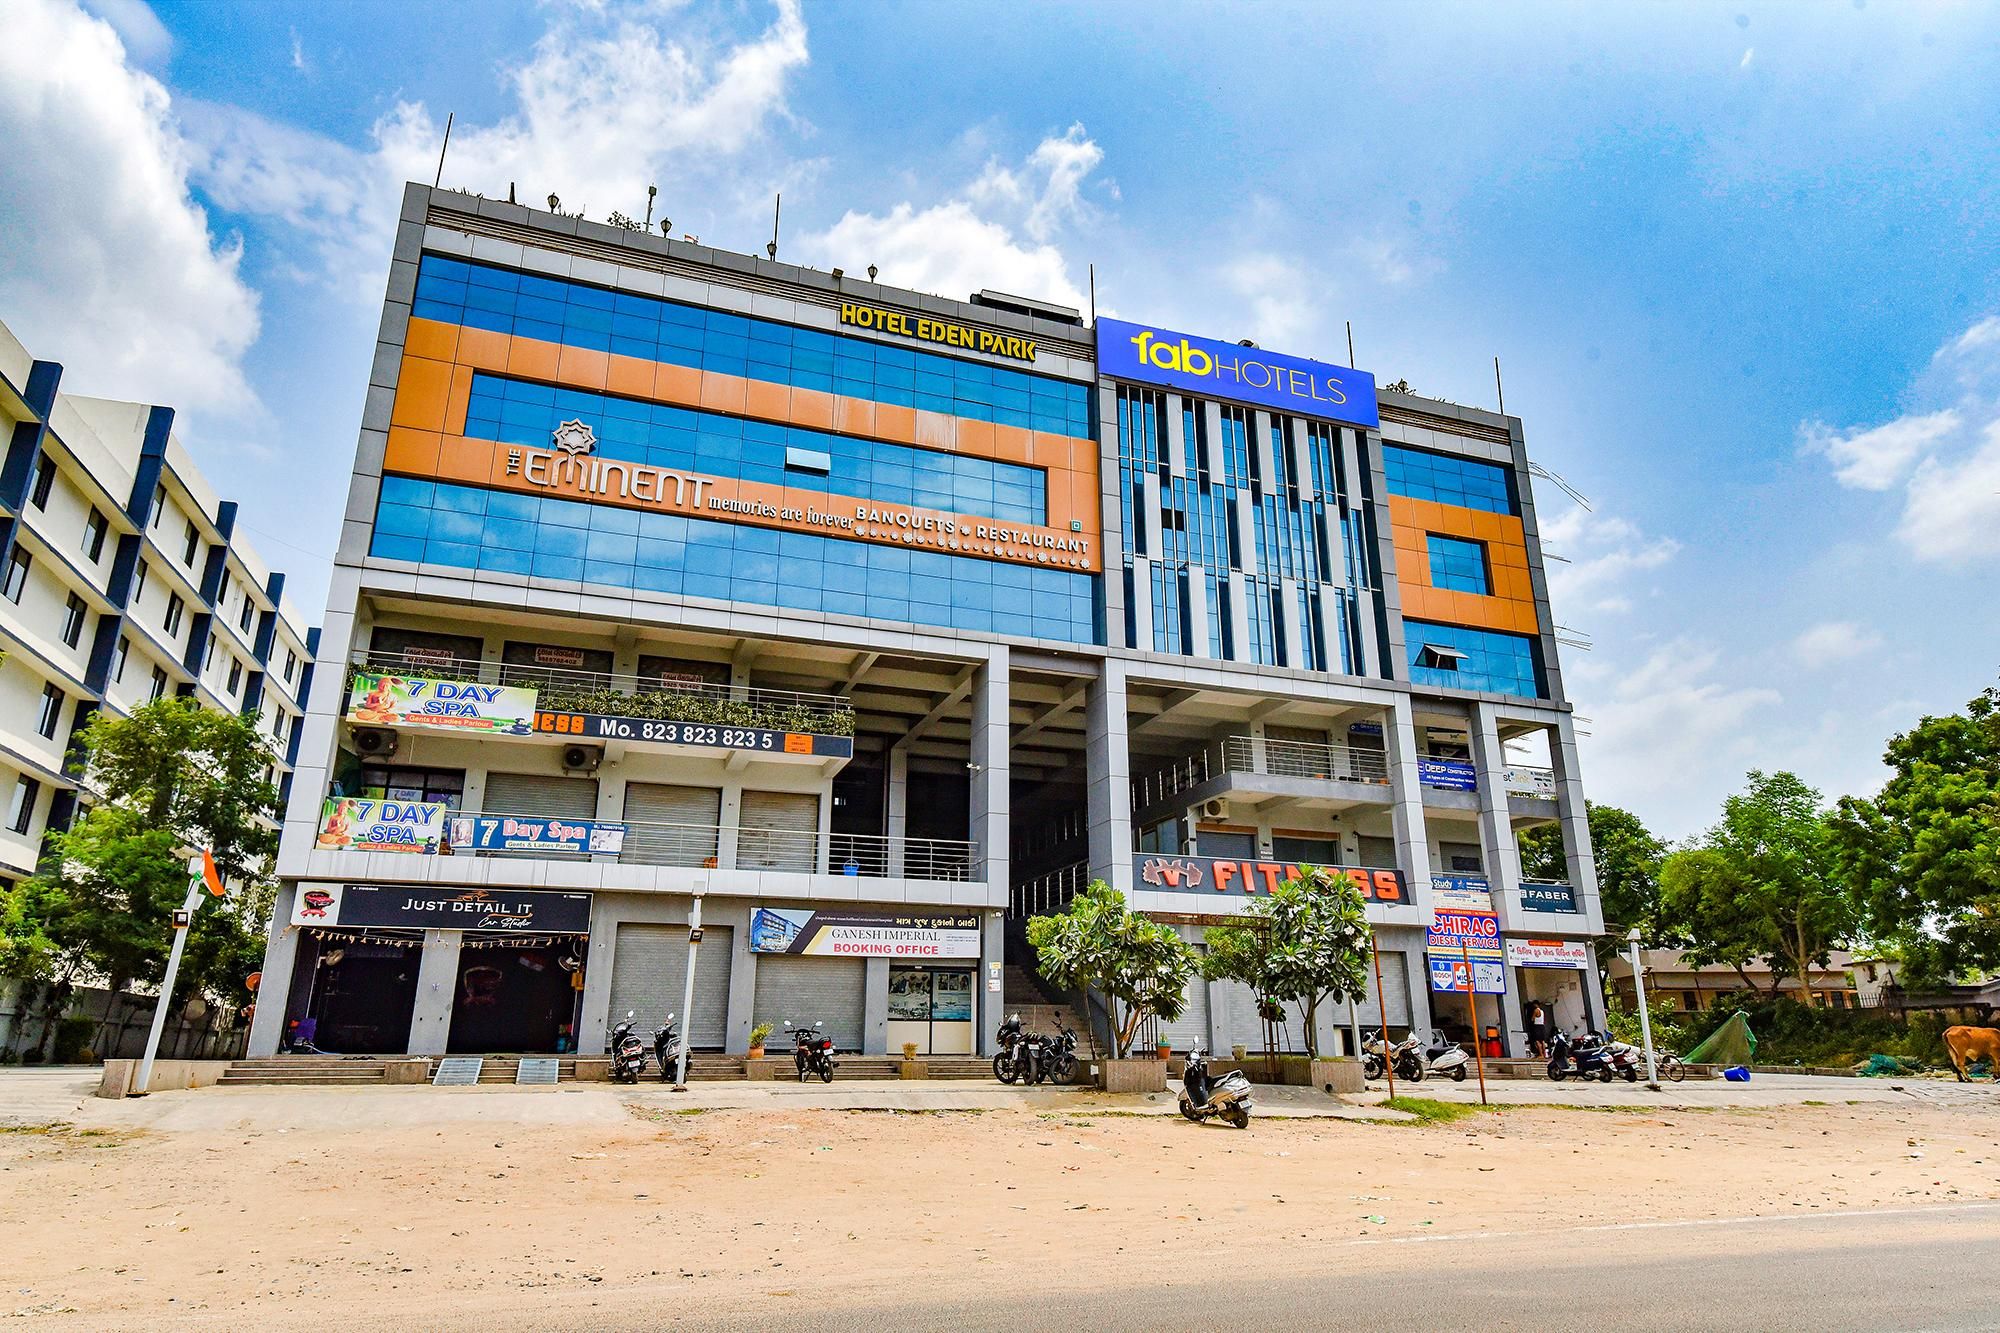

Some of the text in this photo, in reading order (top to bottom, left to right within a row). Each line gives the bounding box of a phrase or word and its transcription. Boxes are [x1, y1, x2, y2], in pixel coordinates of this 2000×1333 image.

[841, 303, 1037, 361] HOTEL EDEN PARK
[506, 447, 522, 475] THE
[708, 495, 854, 530] memories are forever
[856, 506, 1089, 553] BANQUETS RESTAURANT
[407, 681, 504, 704] 7 DAY
[423, 700, 480, 718] SPA
[409, 716, 431, 724] Gents
[439, 717, 462, 727] Ladies
[463, 719, 490, 728] Parlour
[599, 718, 636, 738] Mo.
[642, 722, 677, 741] 823
[683, 726, 717, 745] 823
[722, 729, 756, 748] 823
[761, 733, 773, 749] 5
[1425, 763, 1446, 773] DEEP
[357, 801, 439, 825] 7 DAY
[369, 824, 416, 844] SPA
[480, 820, 586, 846] 7 Day Spa
[555, 842, 578, 850] Parlour
[1433, 879, 1453, 889] Study
[1529, 890, 1570, 900] FABER
[401, 898, 533, 914] JUST DETAIL IT
[477, 916, 532, 929] Car Studio
[896, 917, 911, 925] માત્ર
[957, 918, 976, 927] બાકી
[1430, 916, 1497, 936] CHIRAG
[832, 929, 881, 940] GANESH
[884, 930, 941, 941] IMPERIAL
[1429, 935, 1500, 949] DIESEL SERVICE
[834, 943, 892, 954] BOOKING
[895, 944, 939, 955] OFFICE
